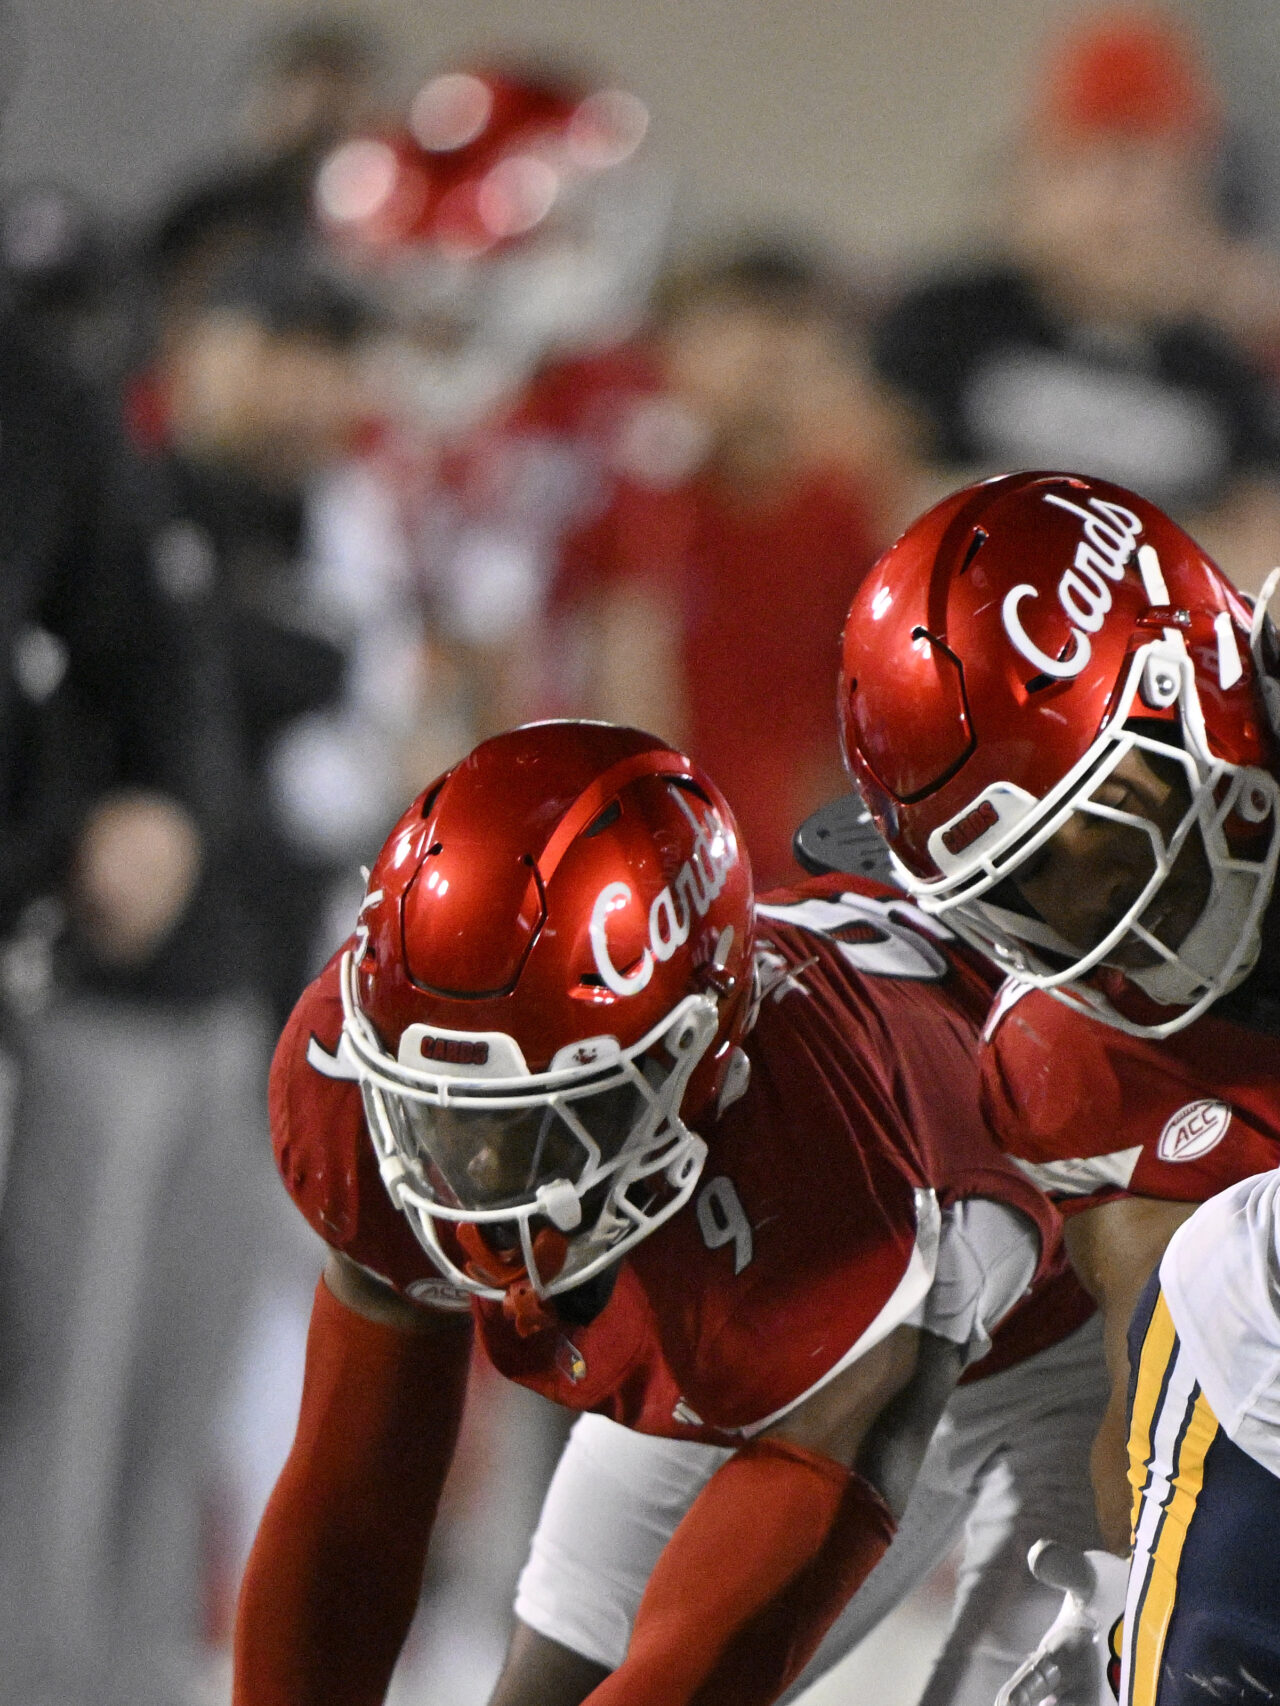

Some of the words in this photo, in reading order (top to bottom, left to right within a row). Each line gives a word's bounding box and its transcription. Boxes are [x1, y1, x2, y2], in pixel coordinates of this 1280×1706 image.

[1002, 494, 1143, 680] Cards
[589, 784, 739, 996] Cards
[1174, 1103, 1218, 1151] ACC
[696, 1175, 753, 1276] 9
